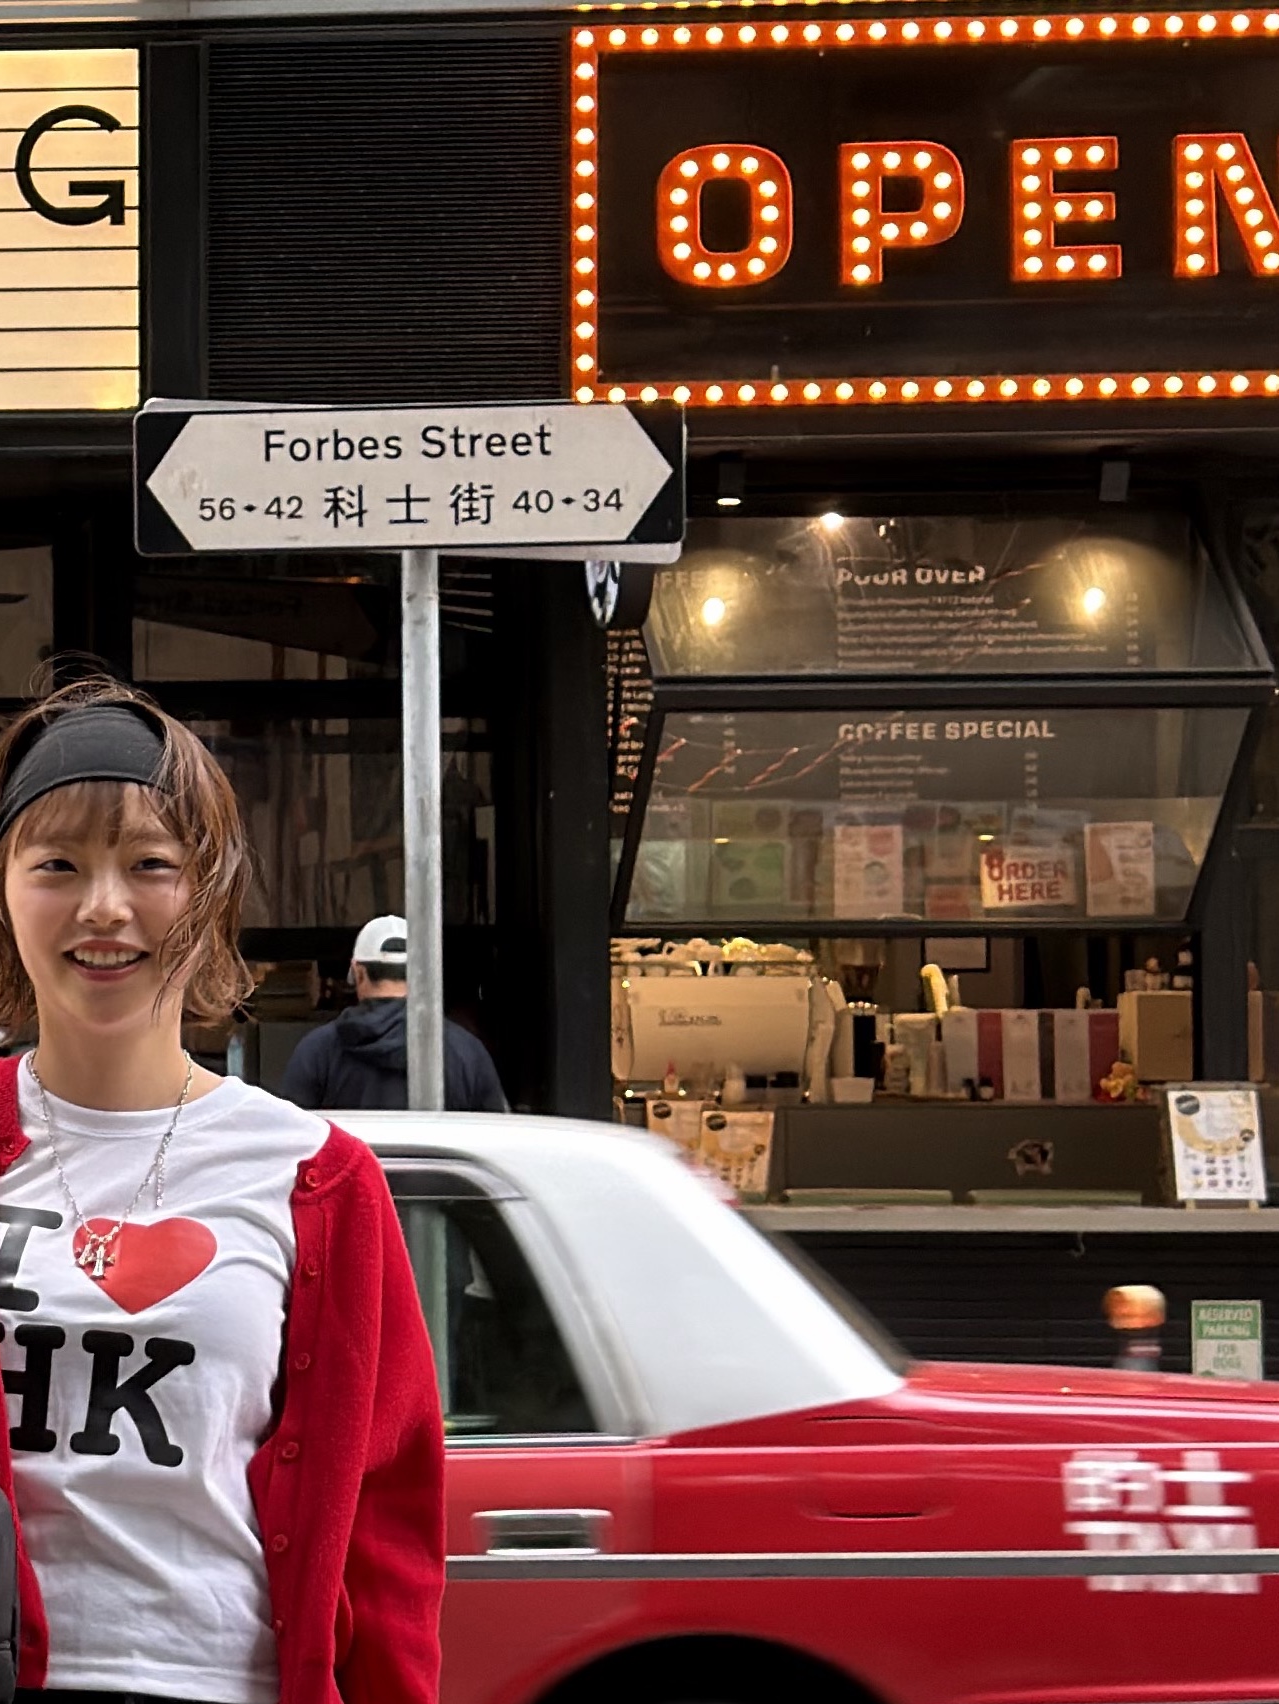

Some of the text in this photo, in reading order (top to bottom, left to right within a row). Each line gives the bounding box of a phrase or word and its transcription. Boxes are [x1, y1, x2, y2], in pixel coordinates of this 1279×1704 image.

[657, 132, 1279, 290] OPEN
[264, 425, 552, 462] Forbes Street
[838, 720, 1056, 741] COFFEE SPECIAL
[987, 859, 1068, 882] ORDER
[996, 881, 1062, 902] HERE
